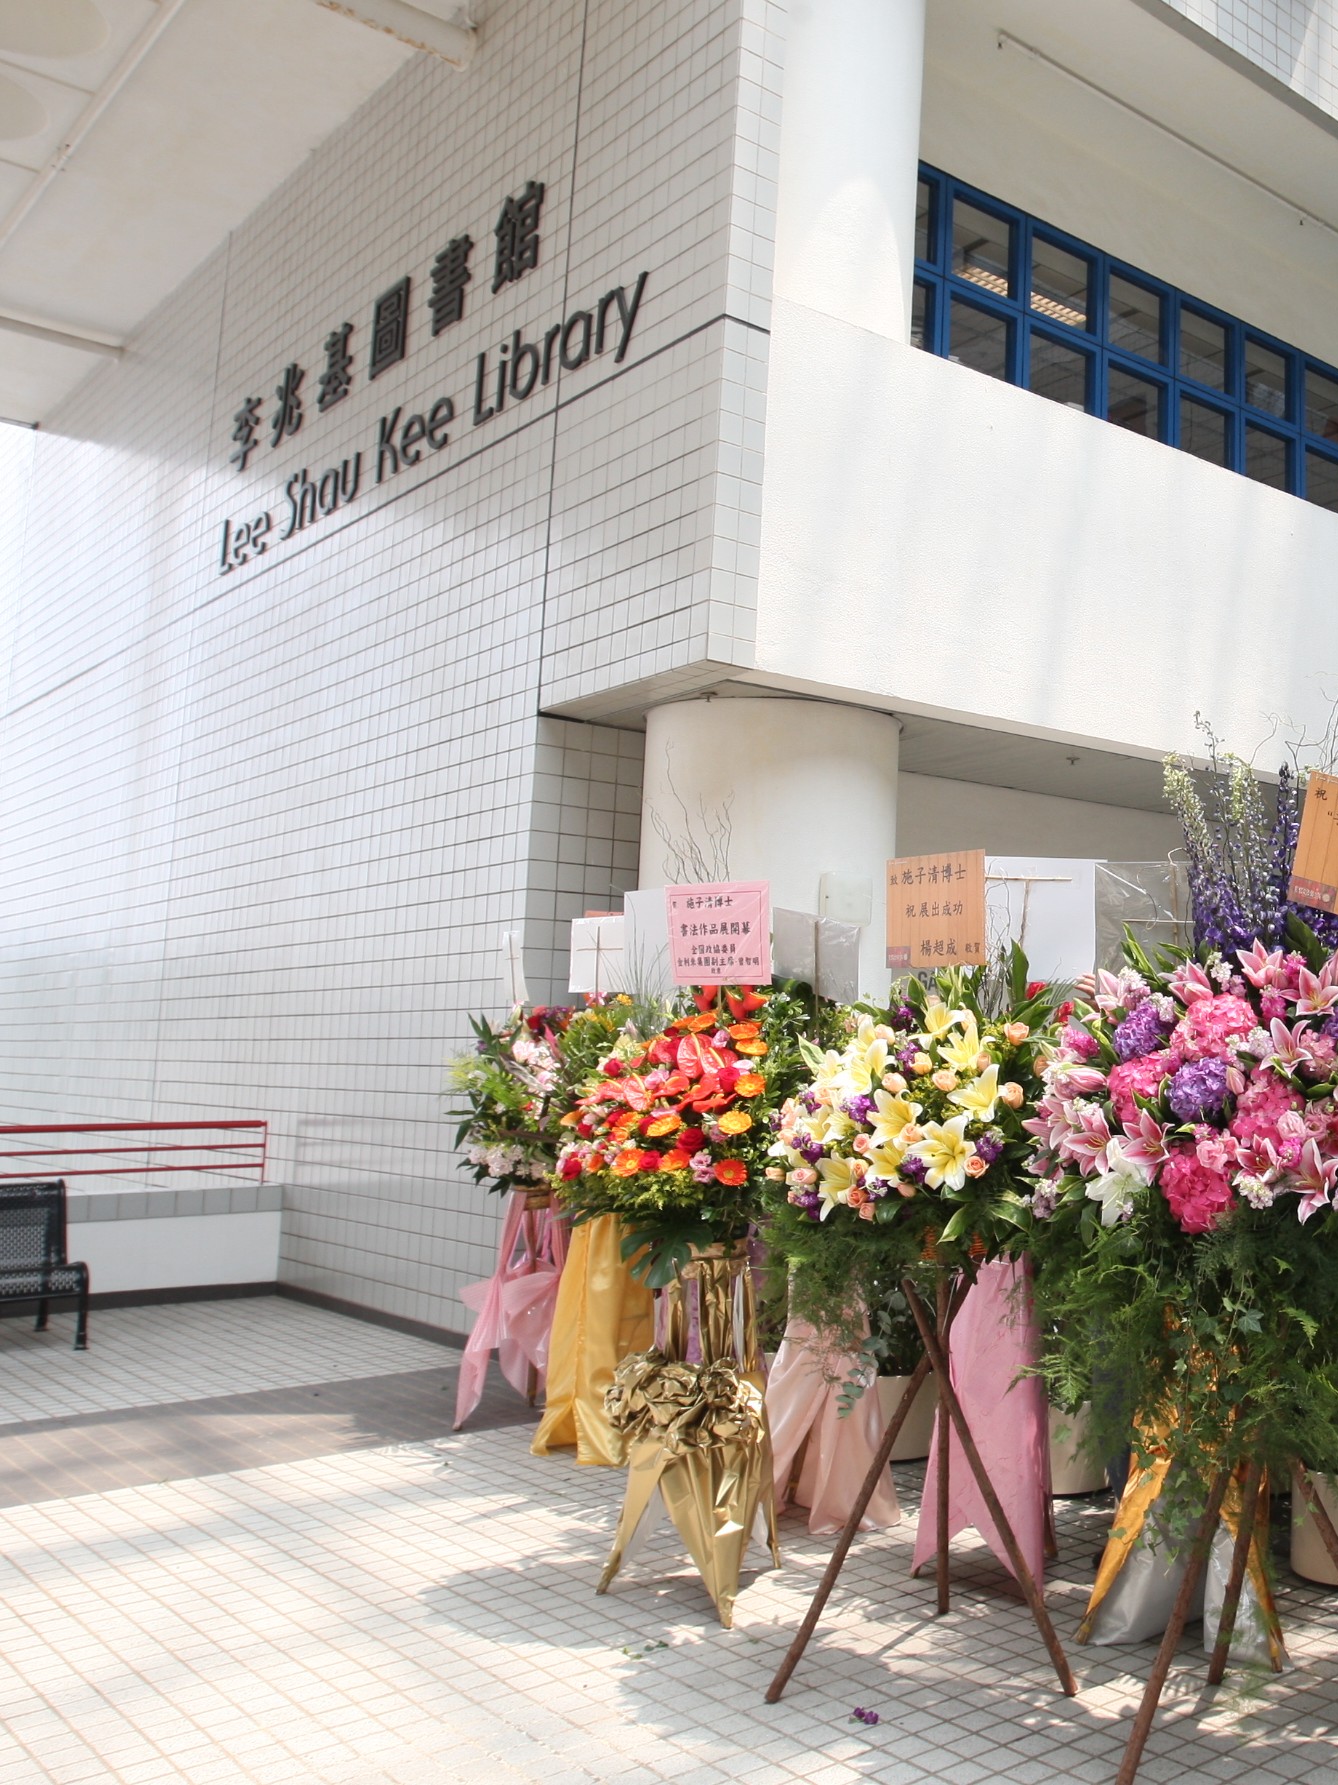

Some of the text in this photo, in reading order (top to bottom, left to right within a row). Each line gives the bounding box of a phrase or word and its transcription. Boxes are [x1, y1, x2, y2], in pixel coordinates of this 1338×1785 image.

[219, 271, 649, 575] Lee Shau Kee Library
[229, 179, 545, 472] 李兆基圖書館
[901, 863, 967, 885] 施子清博士
